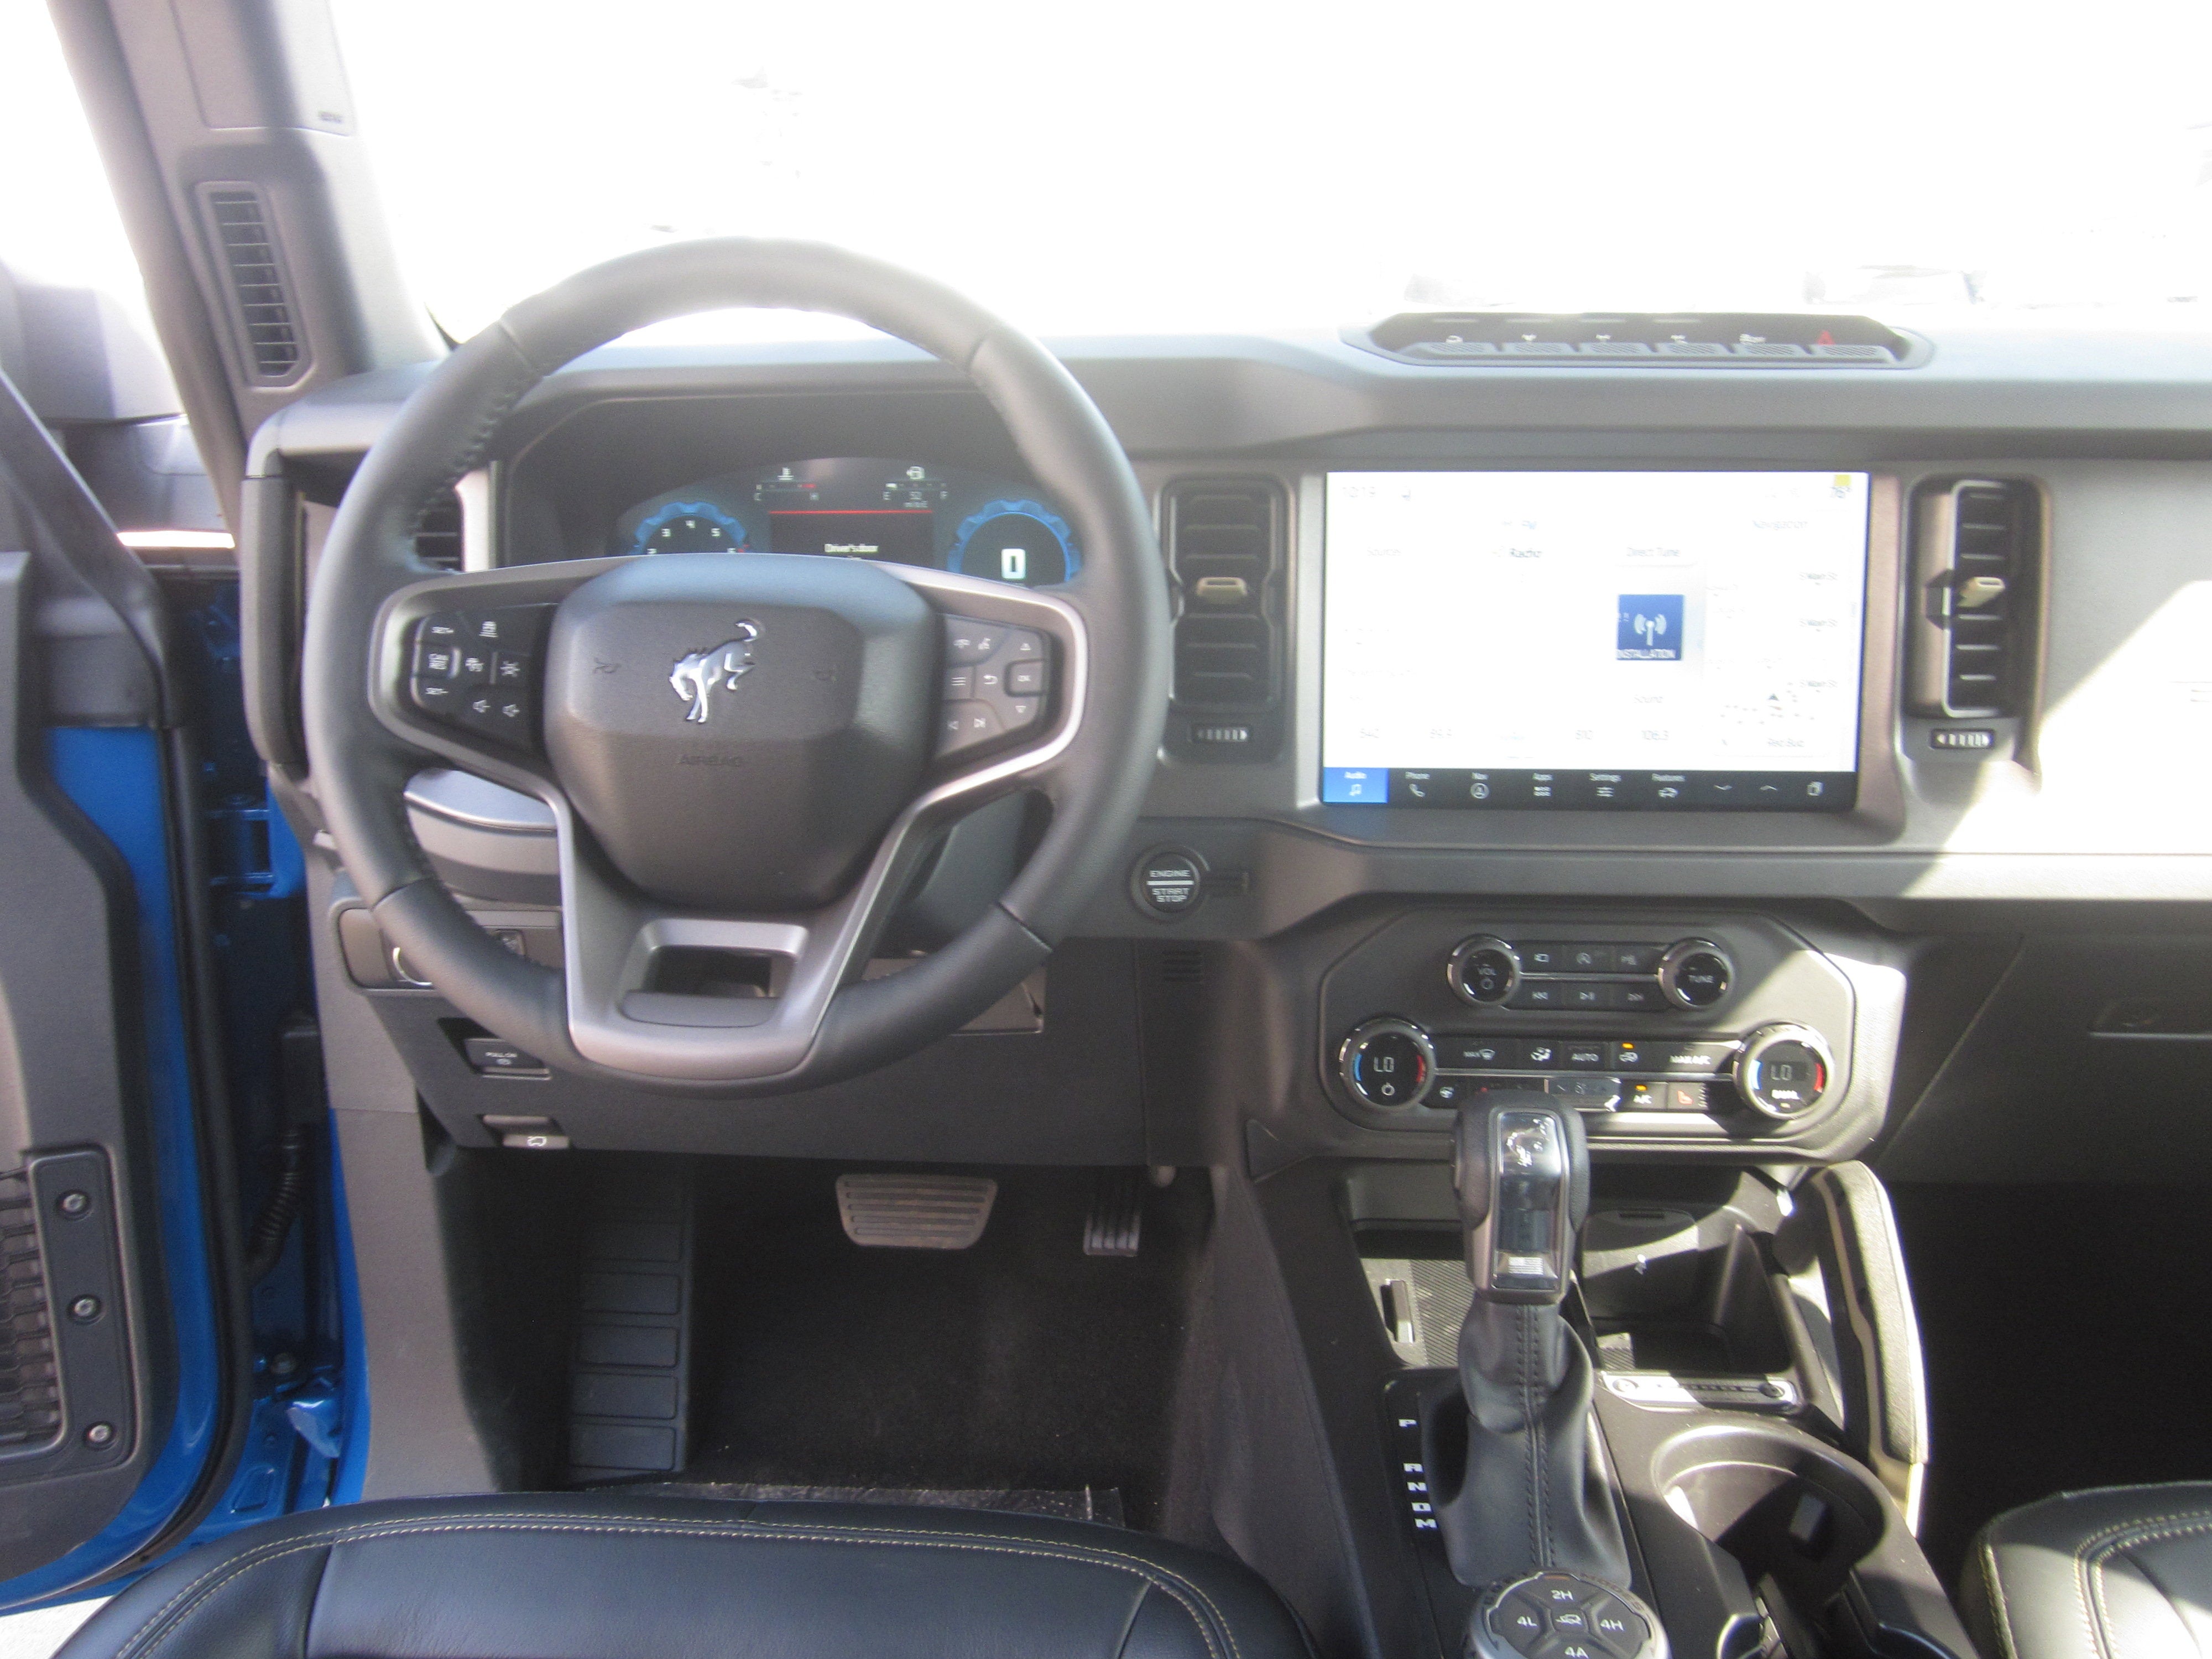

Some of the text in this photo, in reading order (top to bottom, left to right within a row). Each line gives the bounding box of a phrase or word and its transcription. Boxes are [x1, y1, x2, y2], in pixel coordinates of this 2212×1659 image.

[685, 520, 696, 529] 4
[661, 528, 671, 537] 3
[711, 528, 721, 537] 5
[1001, 548, 1026, 579] 0
[1477, 967, 1497, 976] VOL
[1633, 1094, 1652, 1104] A/C
[1399, 1418, 1417, 1427] P
[1407, 1482, 1427, 1491] N
[1411, 1502, 1432, 1512] D
[1415, 1518, 1437, 1528] M
[1551, 1590, 1574, 1600] 2H
[1517, 1616, 1538, 1626] 4L
[1600, 1619, 1624, 1631] 4H
[1564, 1647, 1589, 1658] 4A
